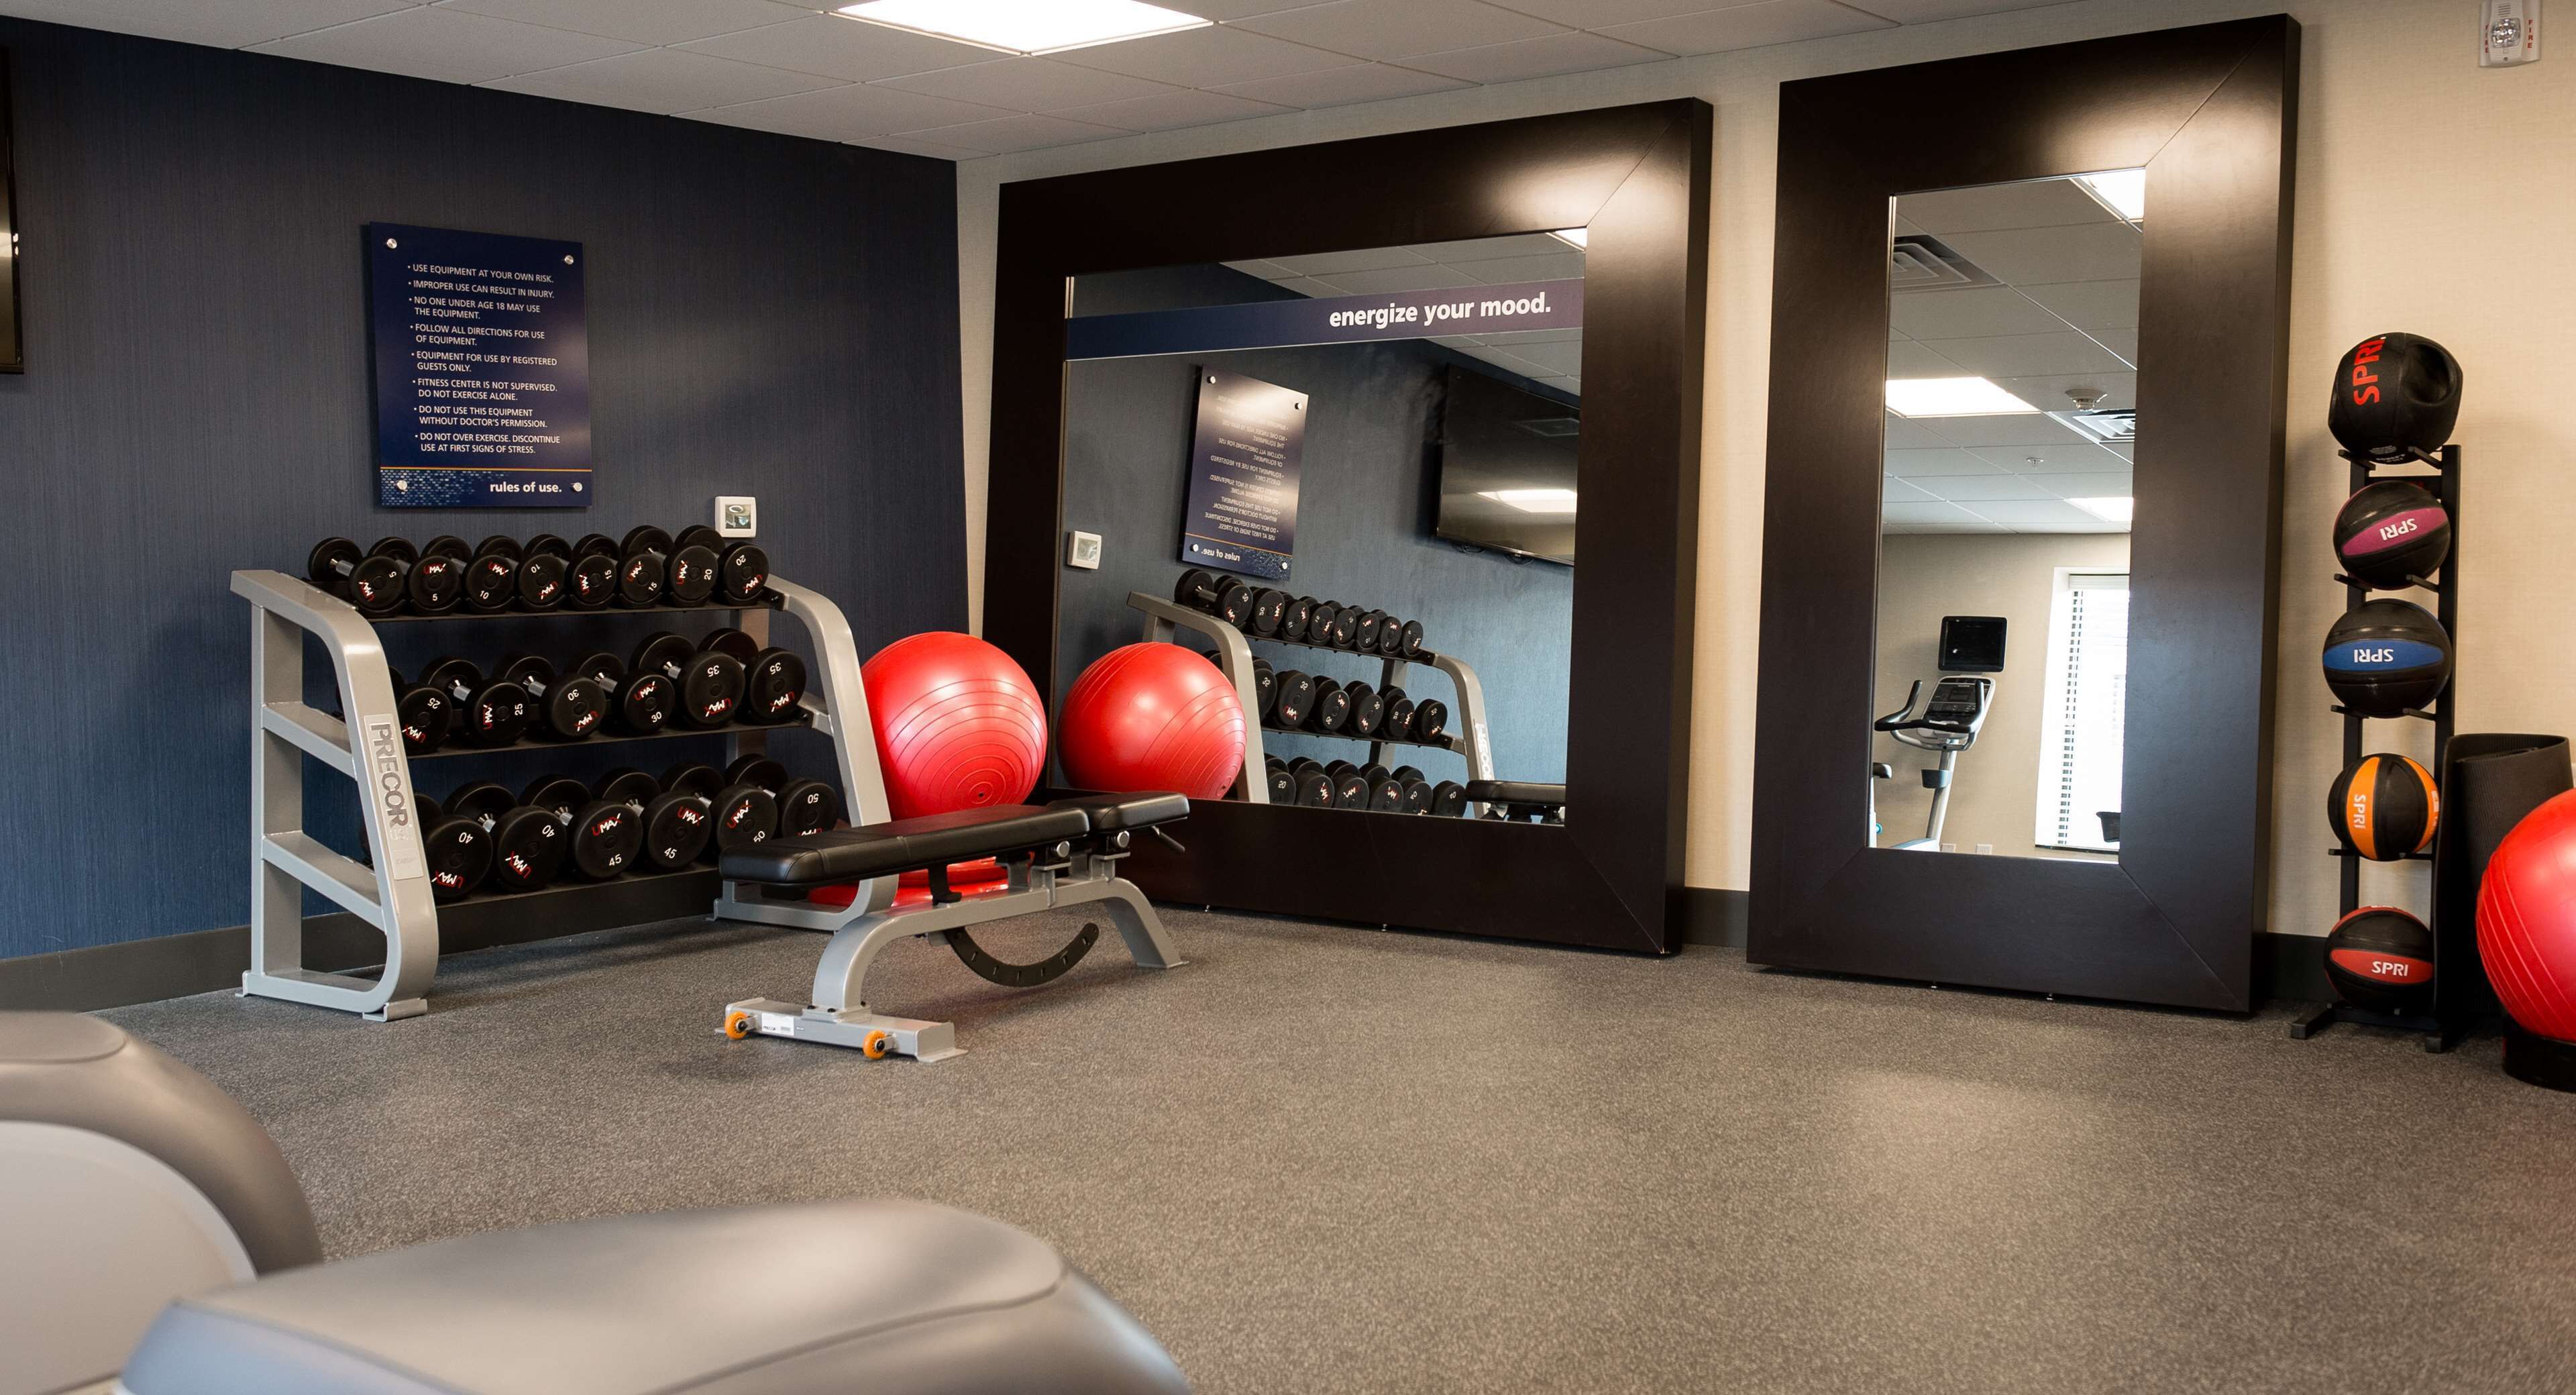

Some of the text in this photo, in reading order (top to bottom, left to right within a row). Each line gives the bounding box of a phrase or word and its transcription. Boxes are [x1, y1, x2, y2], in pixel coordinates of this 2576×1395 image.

[413, 264, 427, 272] USE
[430, 265, 476, 277] EQUIPMENT
[490, 270, 512, 279] YOUR
[514, 272, 533, 281] OWN
[536, 274, 553, 282] RISK.
[413, 280, 453, 290] IMPROPER
[455, 283, 469, 291] USE
[472, 285, 488, 293] CAN
[490, 286, 516, 295] RESULT
[527, 289, 553, 298] INJURY.
[414, 296, 427, 304] NO
[429, 297, 445, 305] ONE
[448, 299, 475, 308] UNDER
[477, 301, 493, 309] AGE
[506, 303, 524, 311] MAY
[526, 304, 539, 313] USE
[1330, 291, 1551, 329] energize your mood.
[415, 307, 480, 319] THE EQUIPMENT.
[415, 323, 449, 333] FOLLOW
[451, 325, 466, 333] ALL
[468, 327, 513, 337] DIRECTIONS
[515, 329, 529, 338] FOR
[416, 334, 476, 346] OF EQUIPMENT.
[417, 350, 464, 362] EQUIPMENT
[484, 354, 498, 362] USE
[513, 356, 557, 365] REGISTERED
[417, 362, 471, 372] GUESTS ONLY.
[2353, 338, 2385, 405] SPRI
[418, 378, 448, 386] FITNESS
[451, 379, 481, 388] CENTER
[492, 381, 508, 389] NOT
[511, 382, 557, 391] SUPERVISED.
[453, 391, 487, 399] EXERCISE
[489, 392, 517, 400] ALONE.
[453, 406, 467, 414] USE
[488, 408, 533, 417] EQUIPMENT
[419, 416, 547, 427] WITHOUT DOCTOR'S PERMISSION.
[420, 432, 433, 440] DO
[476, 433, 511, 442] EXERCISE.
[513, 435, 559, 443] DISCONTINUE
[472, 444, 494, 452] SIGNS
[490, 481, 519, 492] rules
[523, 481, 535, 492] of
[2380, 517, 2418, 541] SPRI
[737, 555, 746, 566] 20
[531, 564, 540, 573] 10
[605, 570, 612, 579] 15
[704, 569, 712, 580] 20
[649, 582, 657, 590] 15
[480, 590, 488, 599] 10
[2354, 648, 2394, 663] SPRI
[708, 666, 719, 676] 35
[770, 662, 781, 674] 35
[568, 689, 579, 701] 30
[427, 698, 440, 709] 25
[515, 704, 523, 715] 25
[651, 712, 661, 722] 30
[370, 723, 409, 829] PRECOR
[808, 794, 818, 804] 50
[2353, 794, 2366, 829] SPRI
[542, 825, 554, 837] 40
[753, 831, 765, 842] 50
[459, 832, 473, 843] 40
[664, 847, 677, 858] 45
[609, 854, 621, 866] 45
[2371, 961, 2408, 977] SPRI
